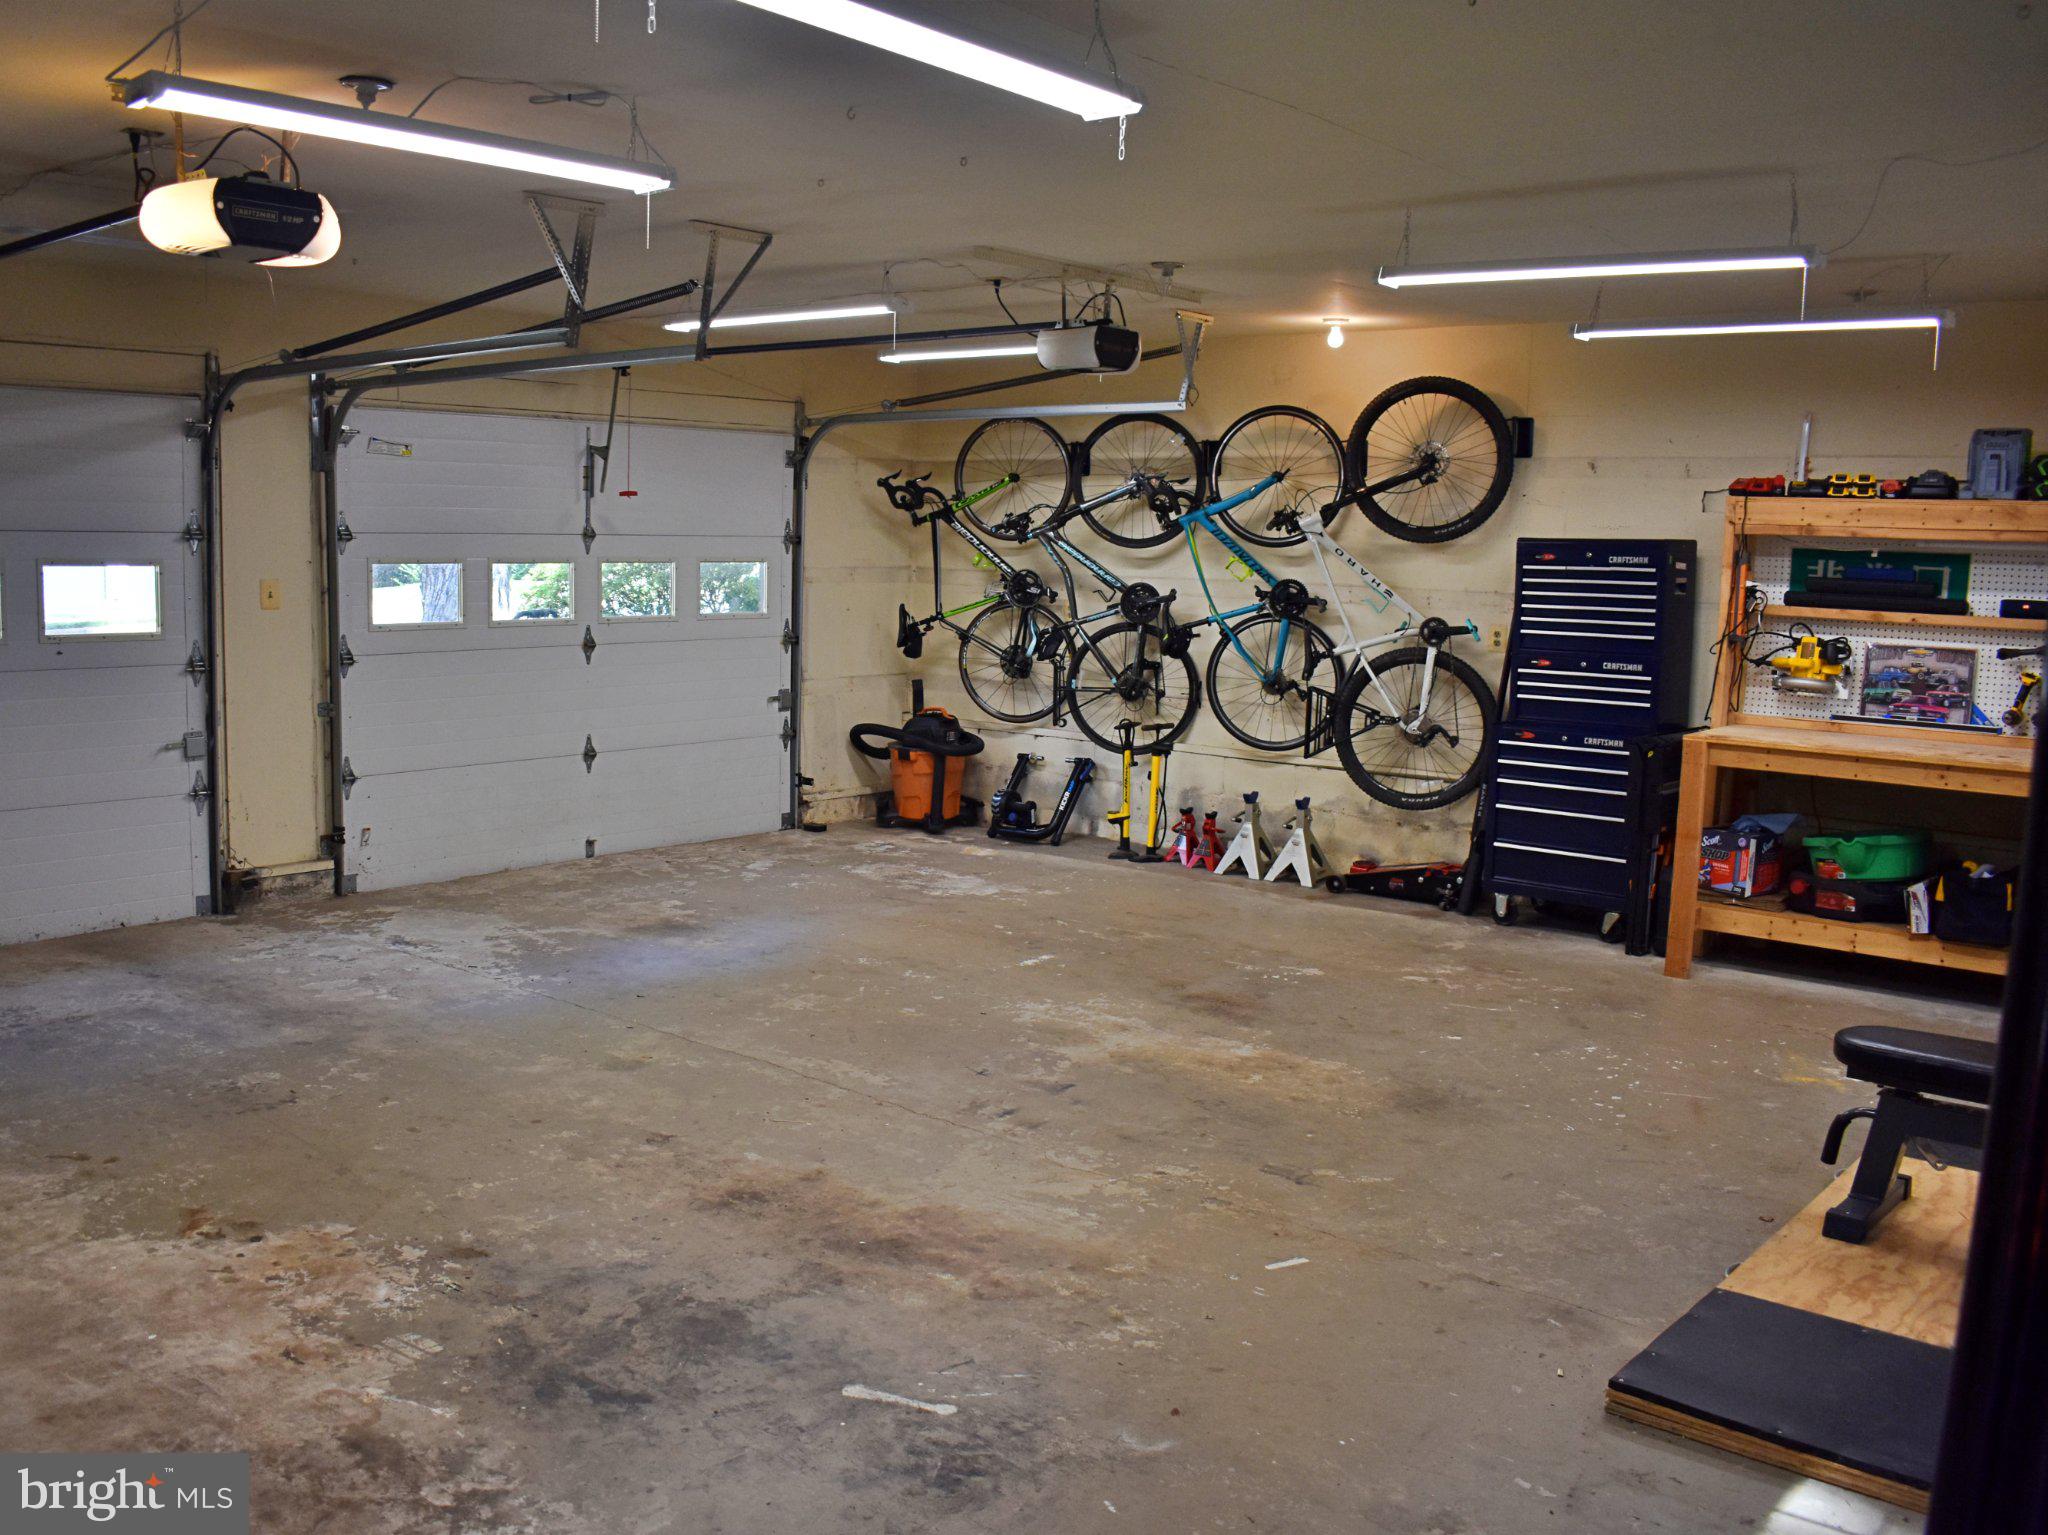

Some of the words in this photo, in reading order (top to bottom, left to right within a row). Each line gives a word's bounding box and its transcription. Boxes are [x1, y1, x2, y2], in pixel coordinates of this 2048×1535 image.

[1608, 555, 1649, 565] CRAFTSMAN
[1334, 547, 1381, 589] HARO
[1602, 661, 1643, 672] CRAFTSMAN
[1583, 737, 1624, 748] CRAFTSMAN
[1059, 791, 1070, 810] KICKR
[1702, 835, 1720, 847] Scott
